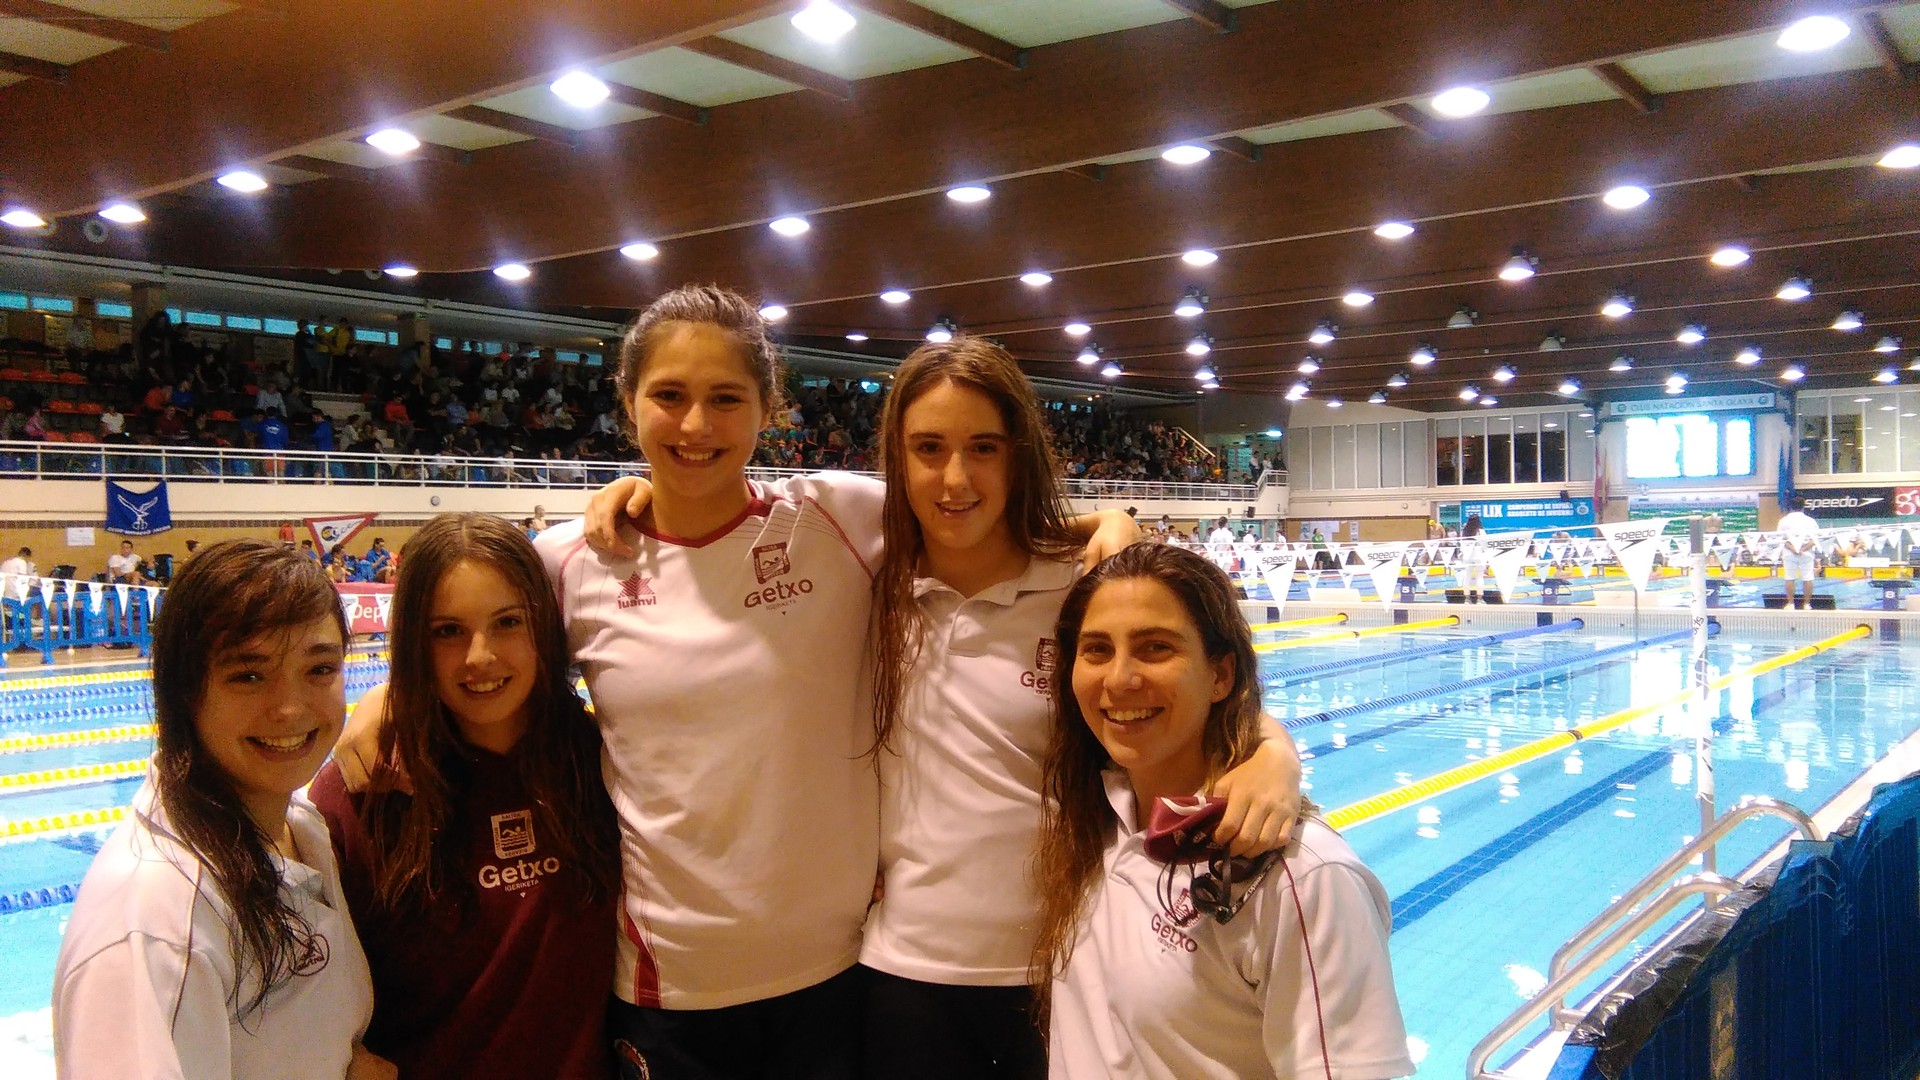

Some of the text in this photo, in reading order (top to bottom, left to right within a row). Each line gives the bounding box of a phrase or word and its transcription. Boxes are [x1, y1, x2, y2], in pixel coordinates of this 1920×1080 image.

[1804, 496, 1858, 510] speedo
[1483, 504, 1503, 518] LIX
[1614, 528, 1656, 541] speedo
[1487, 538, 1525, 548] speedo
[1262, 554, 1293, 565] speedo
[1368, 551, 1400, 561] speedo
[743, 578, 814, 608] Getxo
[1885, 590, 1894, 599] 8
[617, 597, 657, 609] luanvi
[478, 857, 560, 889] Getxo
[1151, 913, 1198, 953] Getxo
